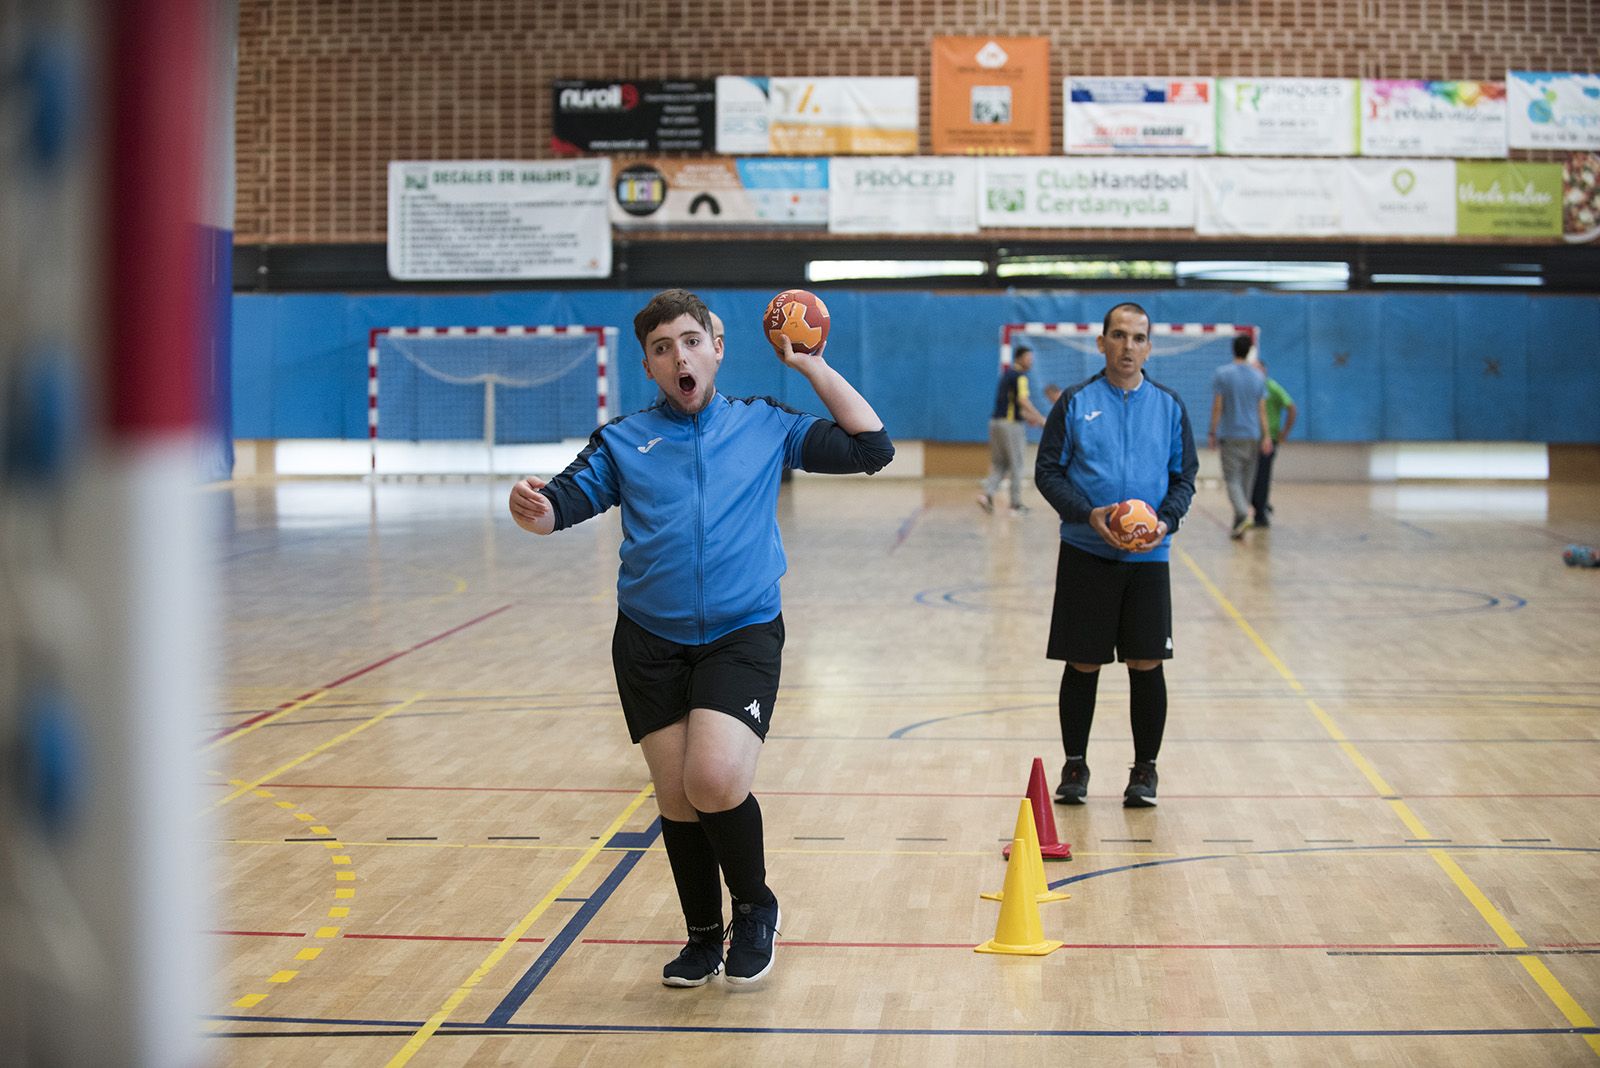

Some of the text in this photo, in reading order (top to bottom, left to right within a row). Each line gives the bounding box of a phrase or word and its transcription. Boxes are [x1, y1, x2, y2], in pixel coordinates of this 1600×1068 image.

[1036, 168, 1188, 190] ClubHandbol
[1036, 192, 1169, 217] Cerdanyola
[771, 293, 789, 328] KIPSTA
